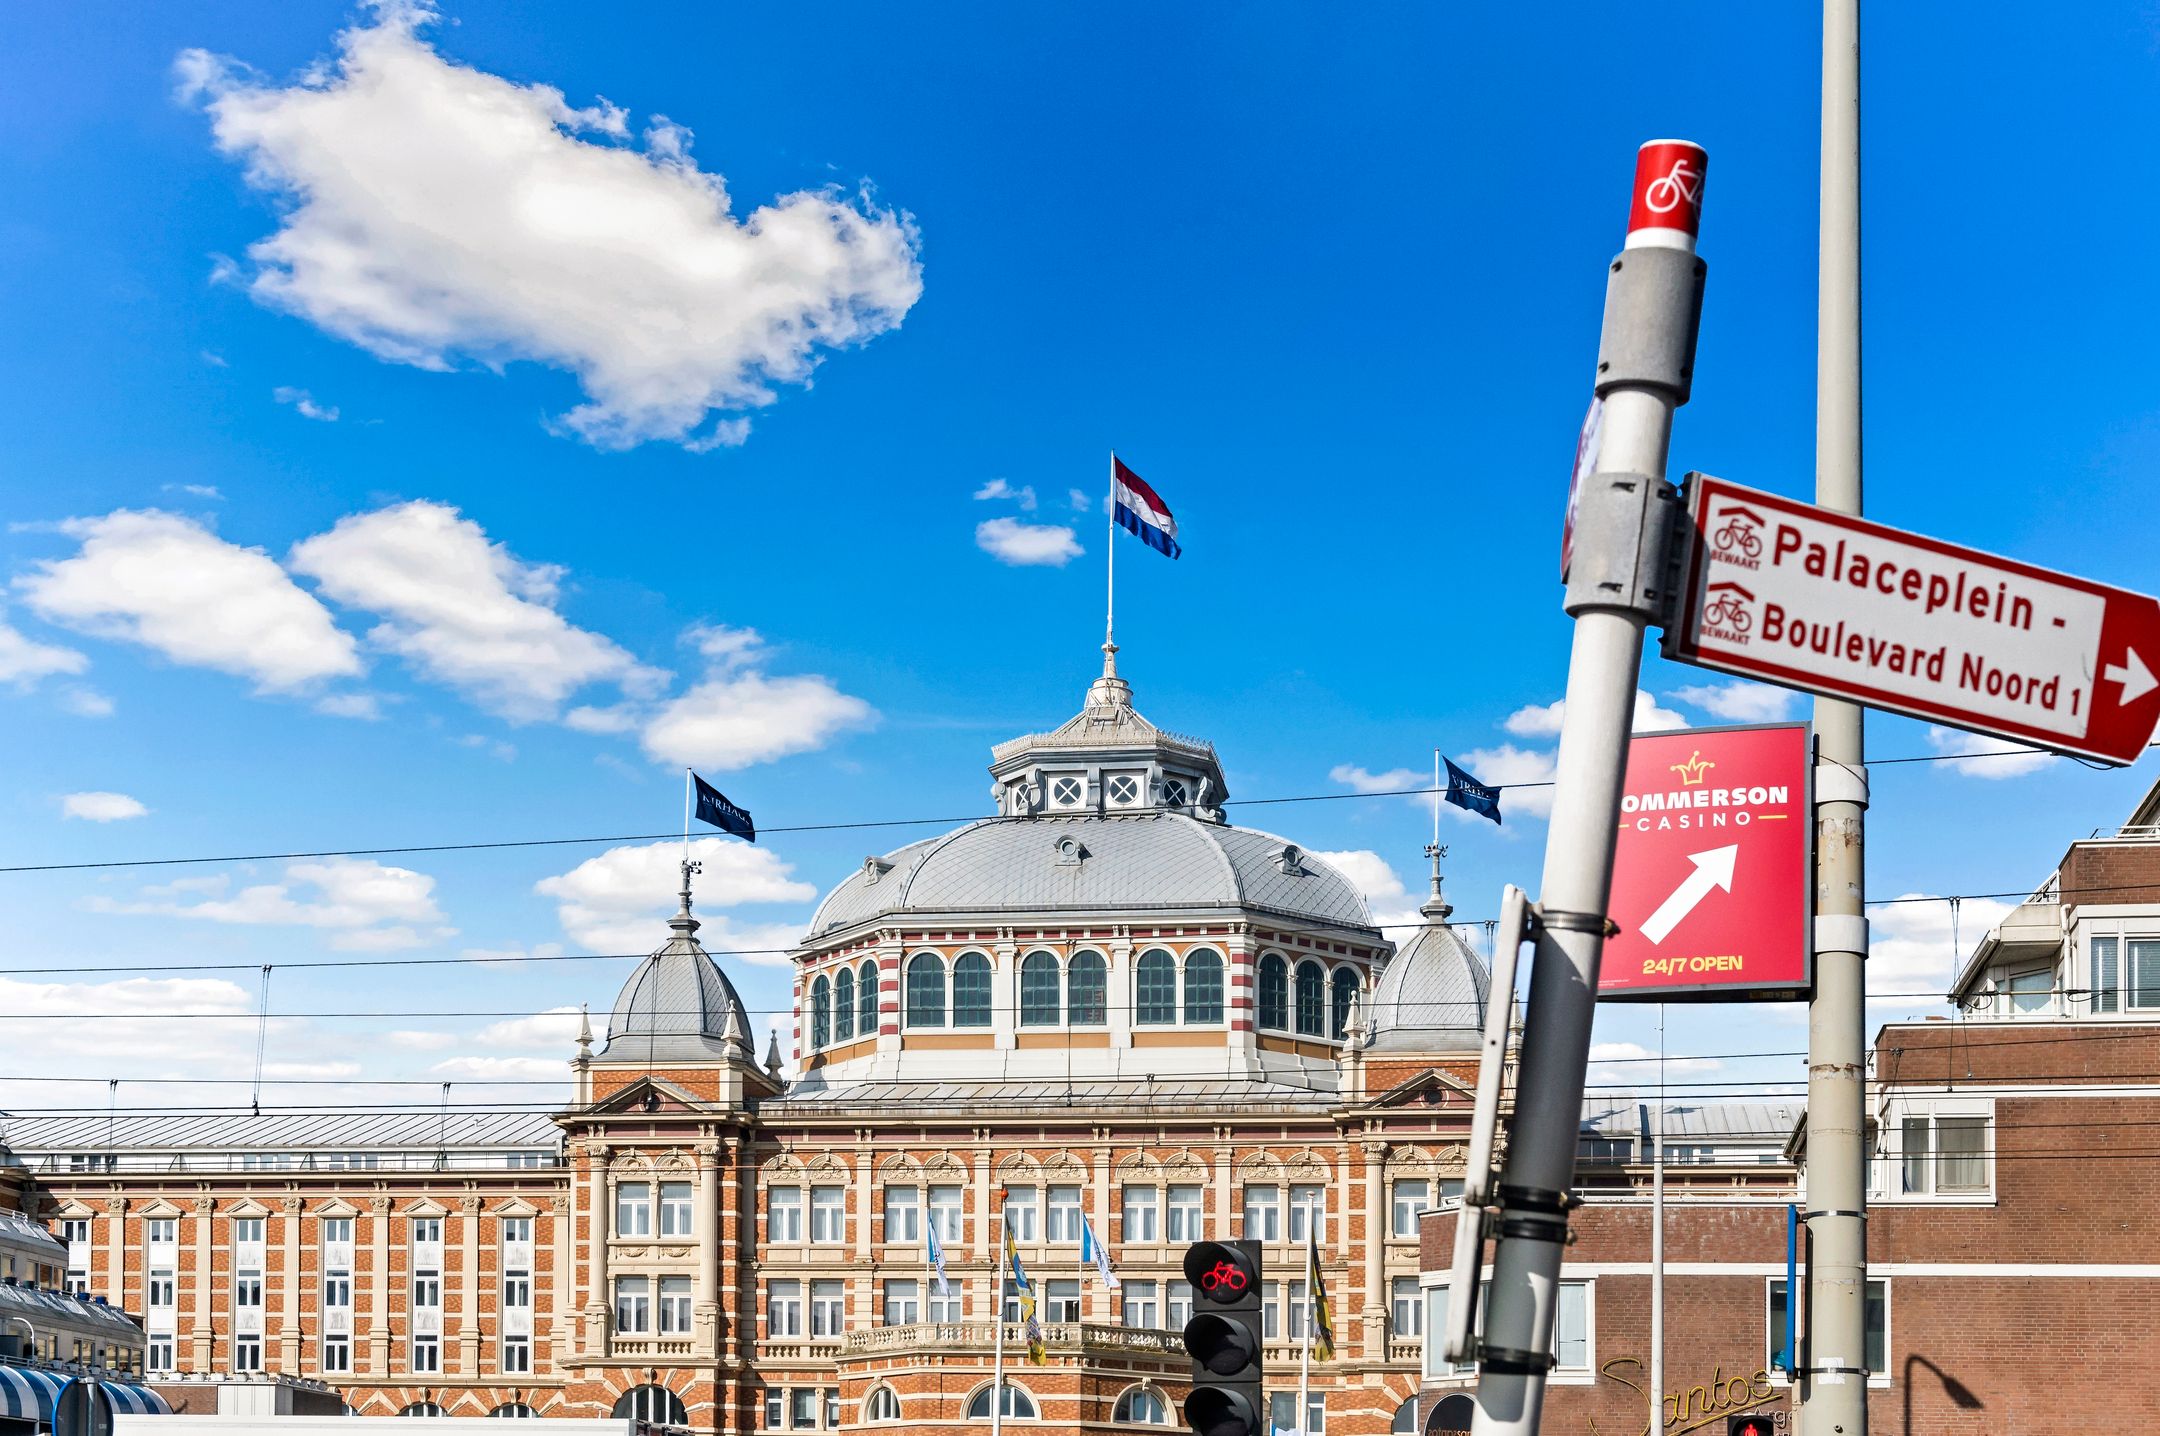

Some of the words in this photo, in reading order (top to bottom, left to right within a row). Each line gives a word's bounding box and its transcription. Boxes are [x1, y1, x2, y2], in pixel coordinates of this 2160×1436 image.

[1711, 549, 1760, 571] BEWAAKT
[1773, 523, 2034, 630] Palaceplein
[1700, 624, 1750, 645] BEWAAKT
[1762, 603, 1944, 683] Boulevard
[1958, 652, 2059, 711] Noord
[2071, 688, 2081, 716] 1
[1621, 786, 1788, 812] OMMERSON
[1637, 811, 1751, 831] CASINO
[1642, 958, 1687, 975] 24/7
[1690, 955, 1743, 971] OPEN
[1588, 1357, 1773, 1436] Santos
